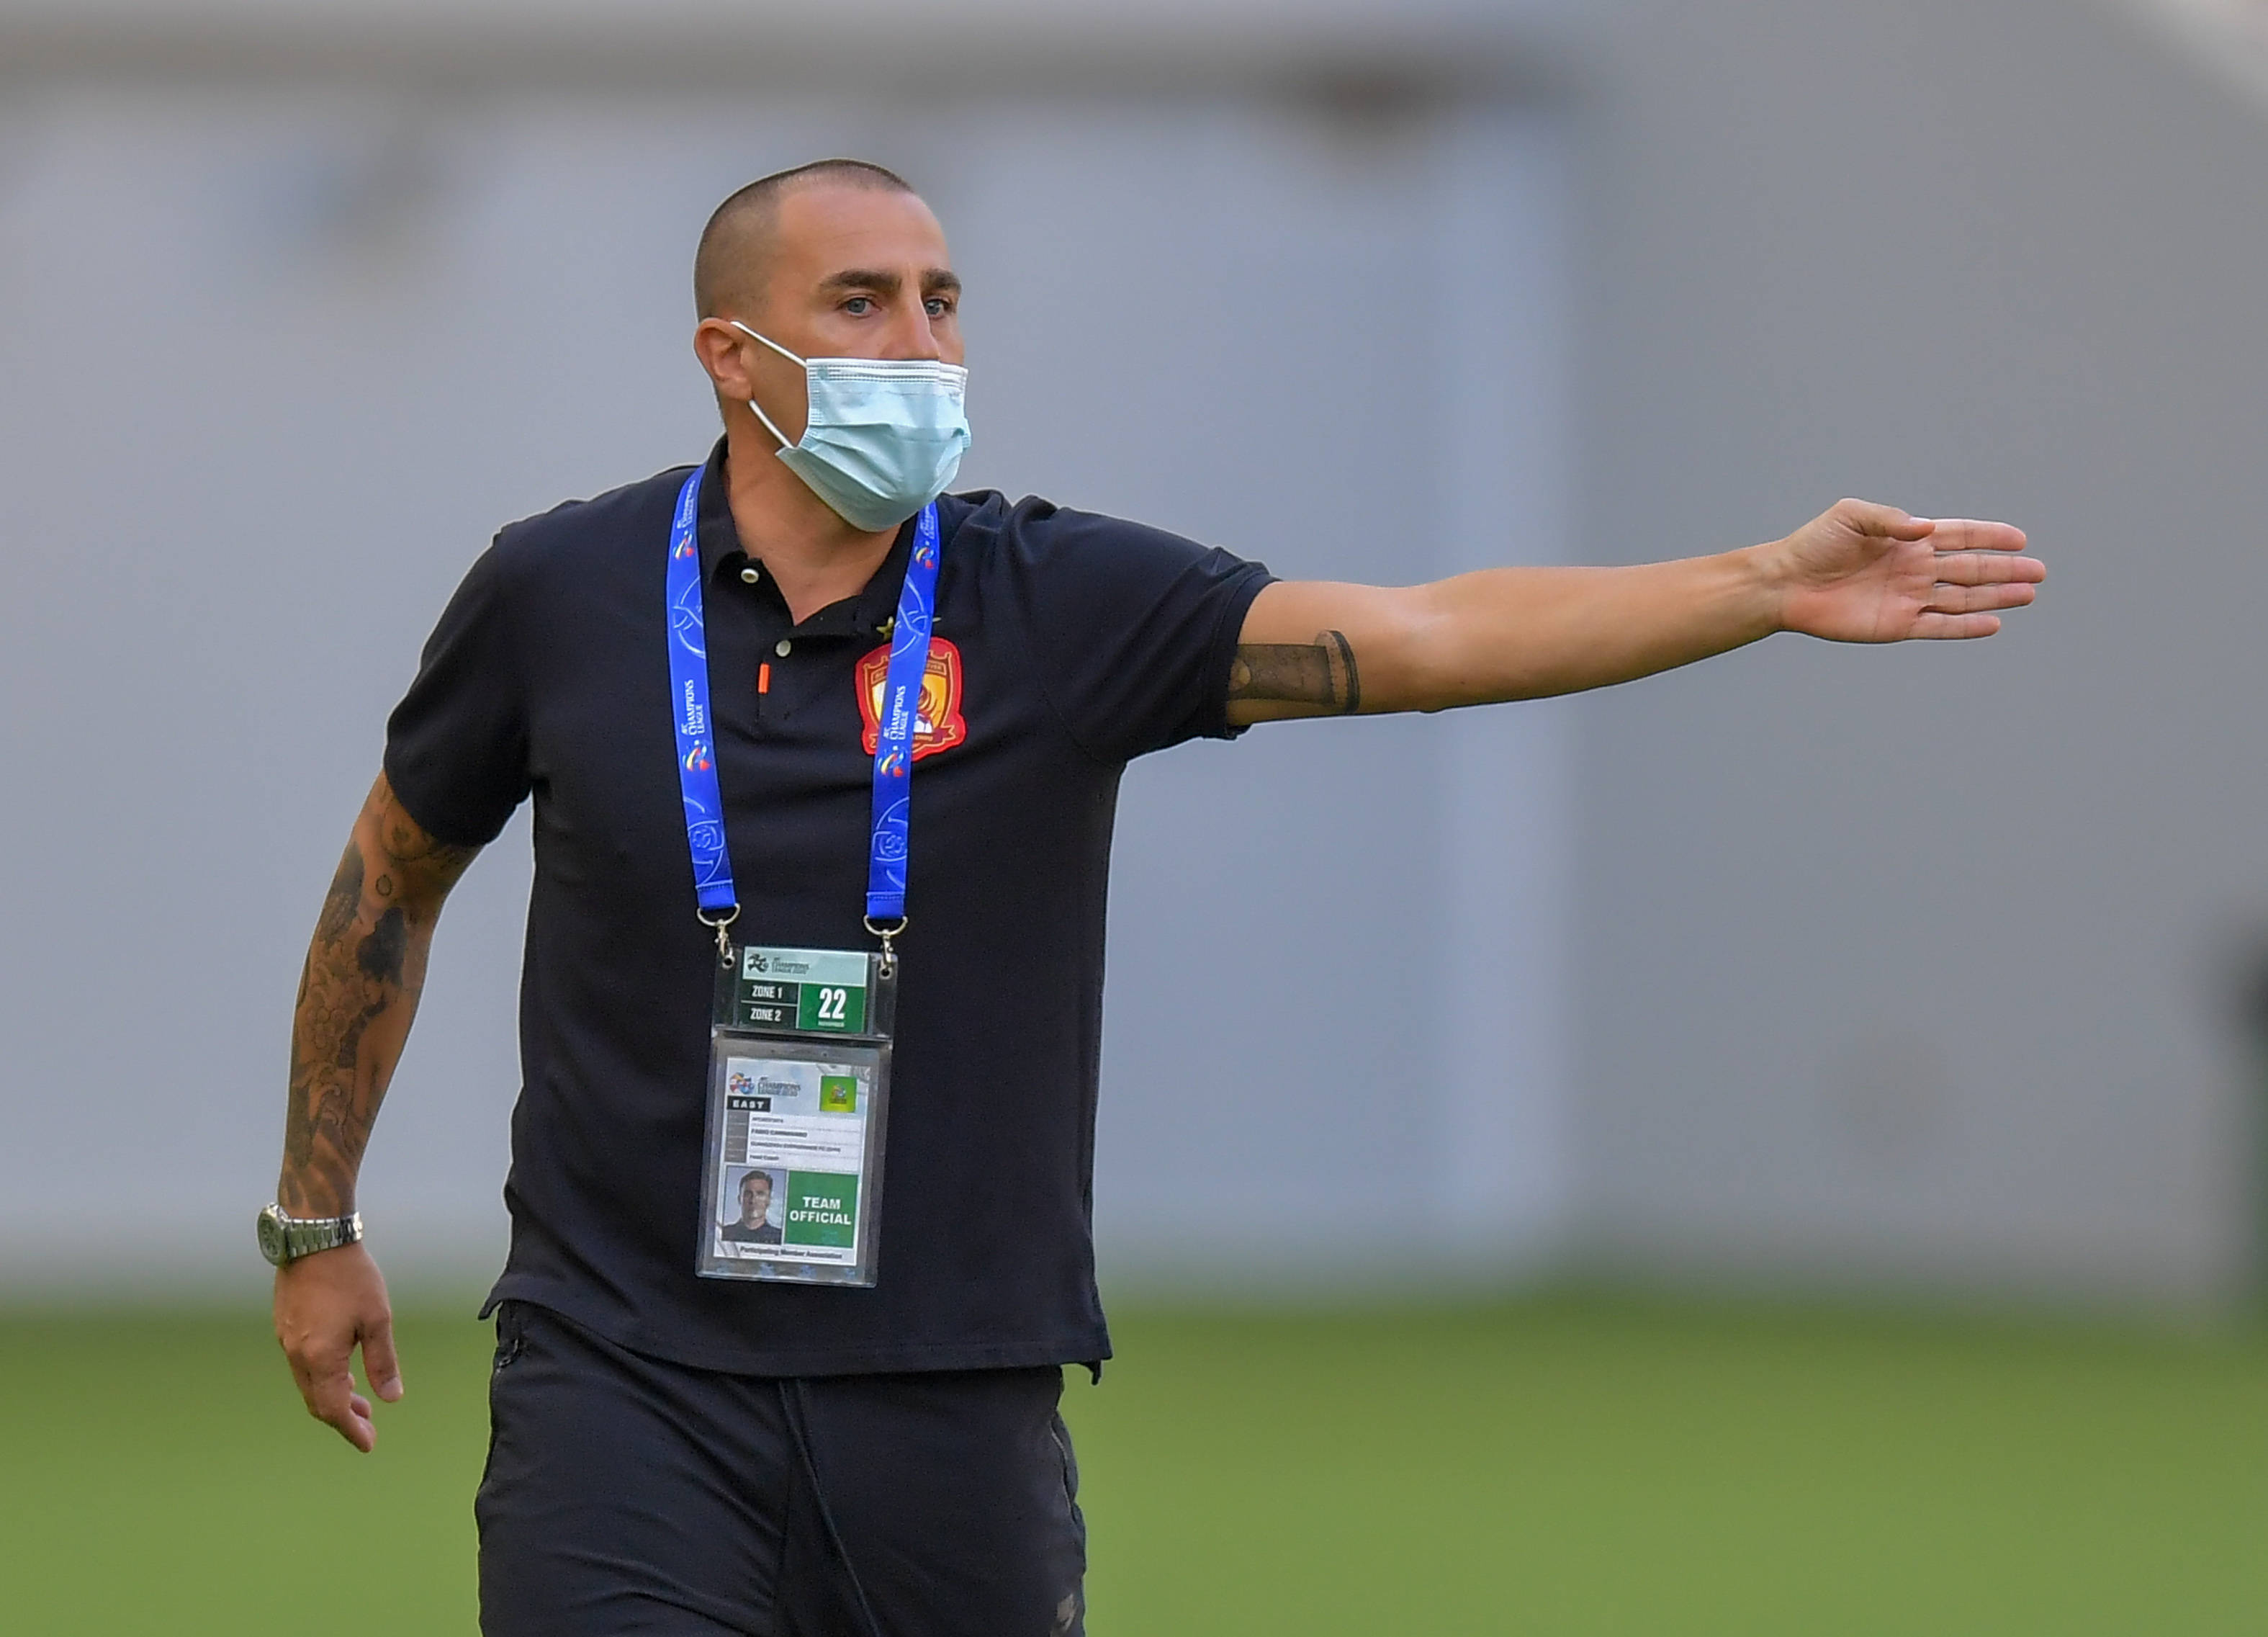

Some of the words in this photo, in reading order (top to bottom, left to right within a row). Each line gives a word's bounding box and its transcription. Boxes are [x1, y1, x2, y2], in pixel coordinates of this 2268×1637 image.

[684, 679, 697, 735] CHAMPIONS
[890, 686, 906, 740] CHAMPIONS
[696, 704, 705, 734] LEAGUE
[898, 711, 909, 740] LEAGUE
[752, 985, 775, 998] ZONE
[778, 987, 783, 999] 1
[818, 987, 847, 1019] 22
[750, 1008, 773, 1021] ZONE
[774, 1010, 782, 1022] 2
[732, 1099, 765, 1109] EAST
[803, 1196, 841, 1210] TEAM
[789, 1210, 852, 1225] OFFICIAL
